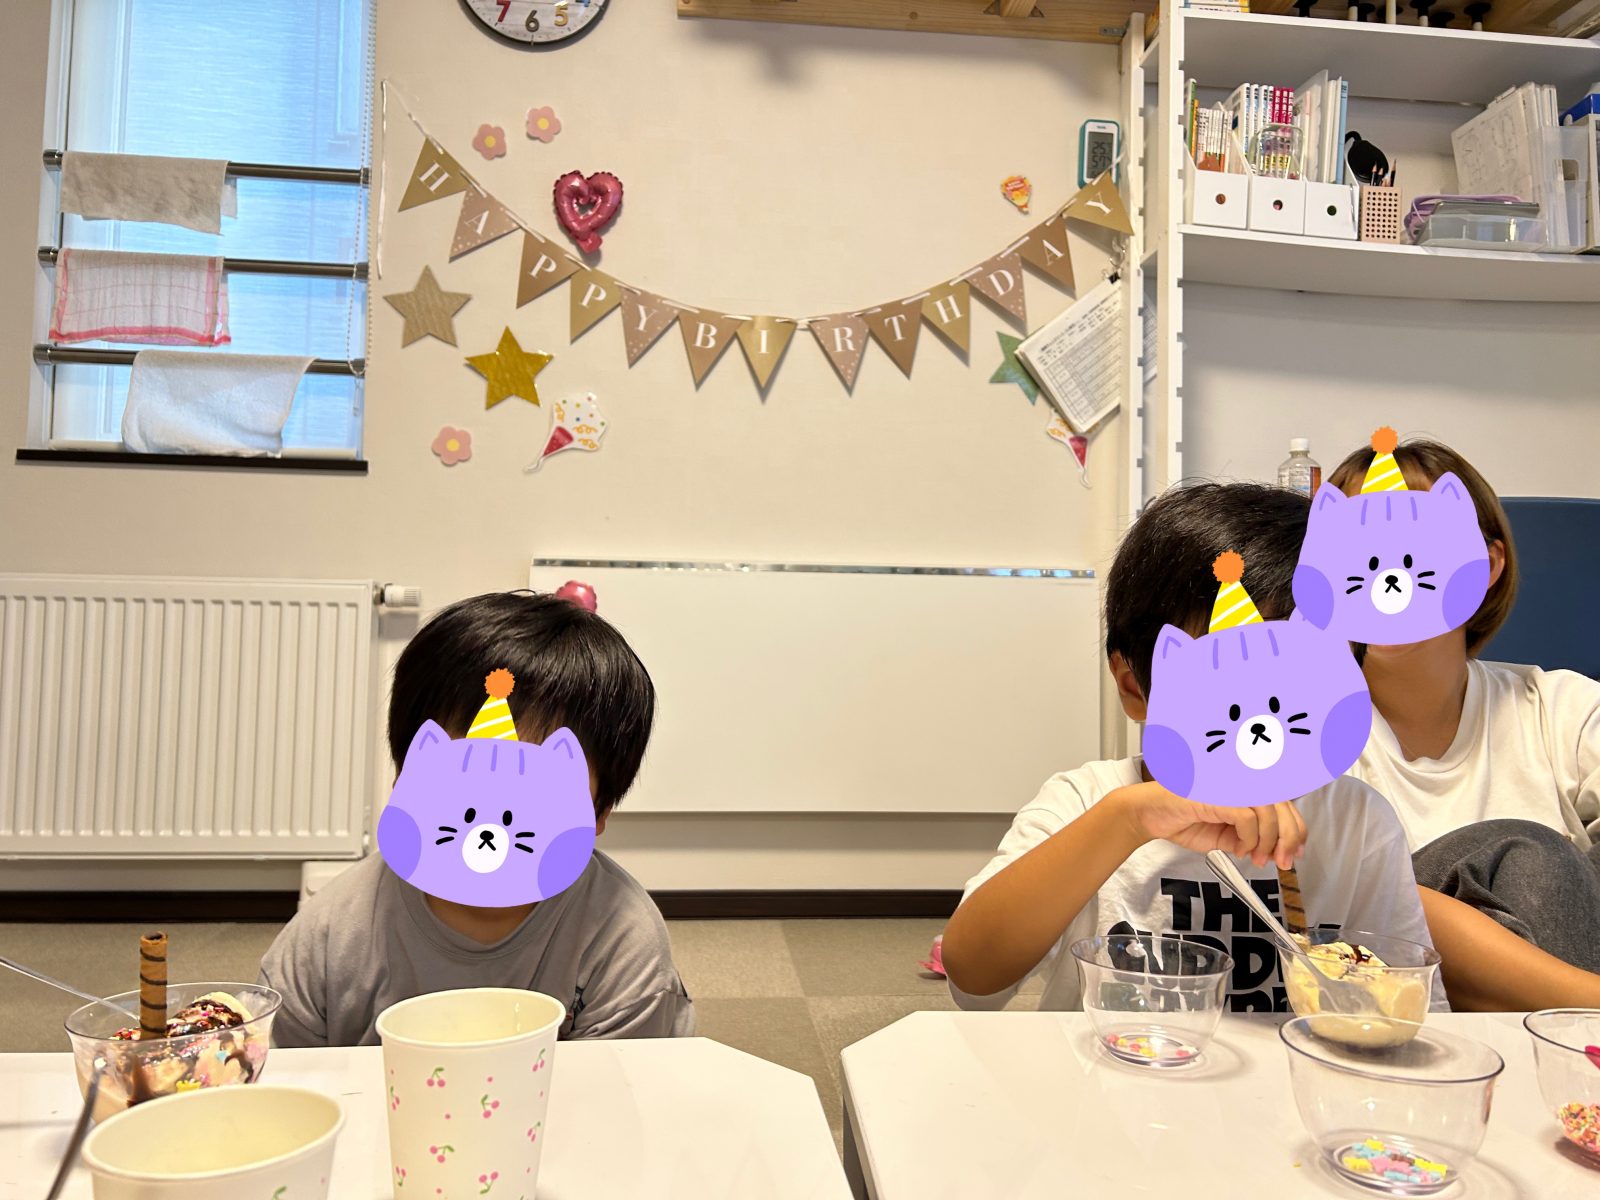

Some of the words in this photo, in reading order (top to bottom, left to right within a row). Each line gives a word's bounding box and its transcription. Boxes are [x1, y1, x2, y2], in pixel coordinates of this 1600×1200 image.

[496, 0, 511, 23] 7
[525, 9, 540, 33] 6
[554, 2, 569, 27] 5
[418, 162, 659, 333] HAPPY
[694, 192, 1113, 354] BIRTHDAY
[1161, 878, 1286, 933] THE
